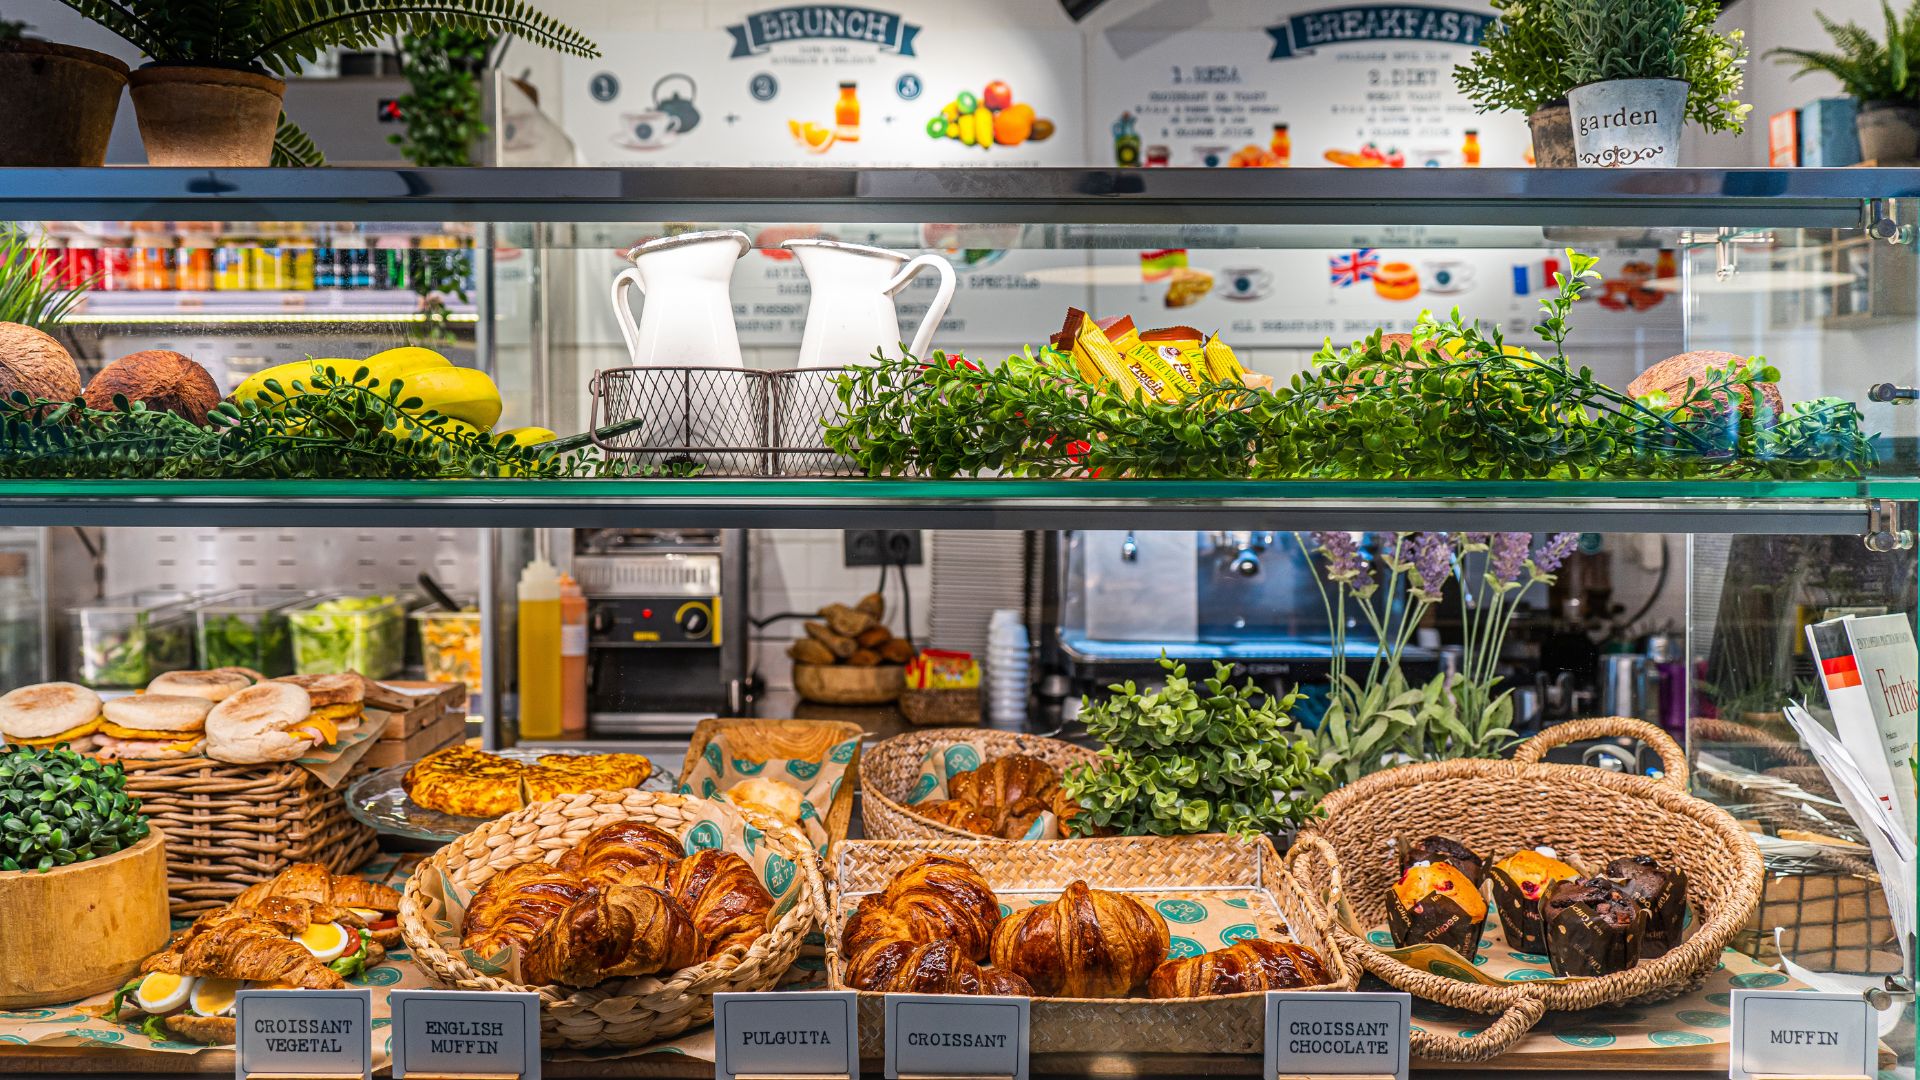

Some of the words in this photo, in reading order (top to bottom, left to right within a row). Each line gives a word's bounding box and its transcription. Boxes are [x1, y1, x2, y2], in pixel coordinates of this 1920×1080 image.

[760, 9, 889, 42] BRUNCH
[1303, 9, 1481, 43] BREAKFAST
[1580, 107, 1658, 136] garden
[1129, 361, 1164, 395] Protein
[698, 832, 712, 844] DO
[773, 858, 787, 872] DO
[771, 866, 794, 889] EAT!
[1176, 903, 1196, 913] DO
[1174, 941, 1194, 952] DO
[255, 1019, 353, 1034] CROISSANT
[426, 1021, 503, 1036] ENGLISH
[1290, 1021, 1389, 1036] CROISSANT
[742, 1031, 831, 1045] PULGUITA
[908, 1032, 1007, 1048] CROISSANT
[1770, 1030, 1838, 1045] MUFFIN
[266, 1038, 342, 1053] VEGETAL
[431, 1040, 498, 1054] MUFFIN
[1290, 1040, 1388, 1054] CHOCOLATE
